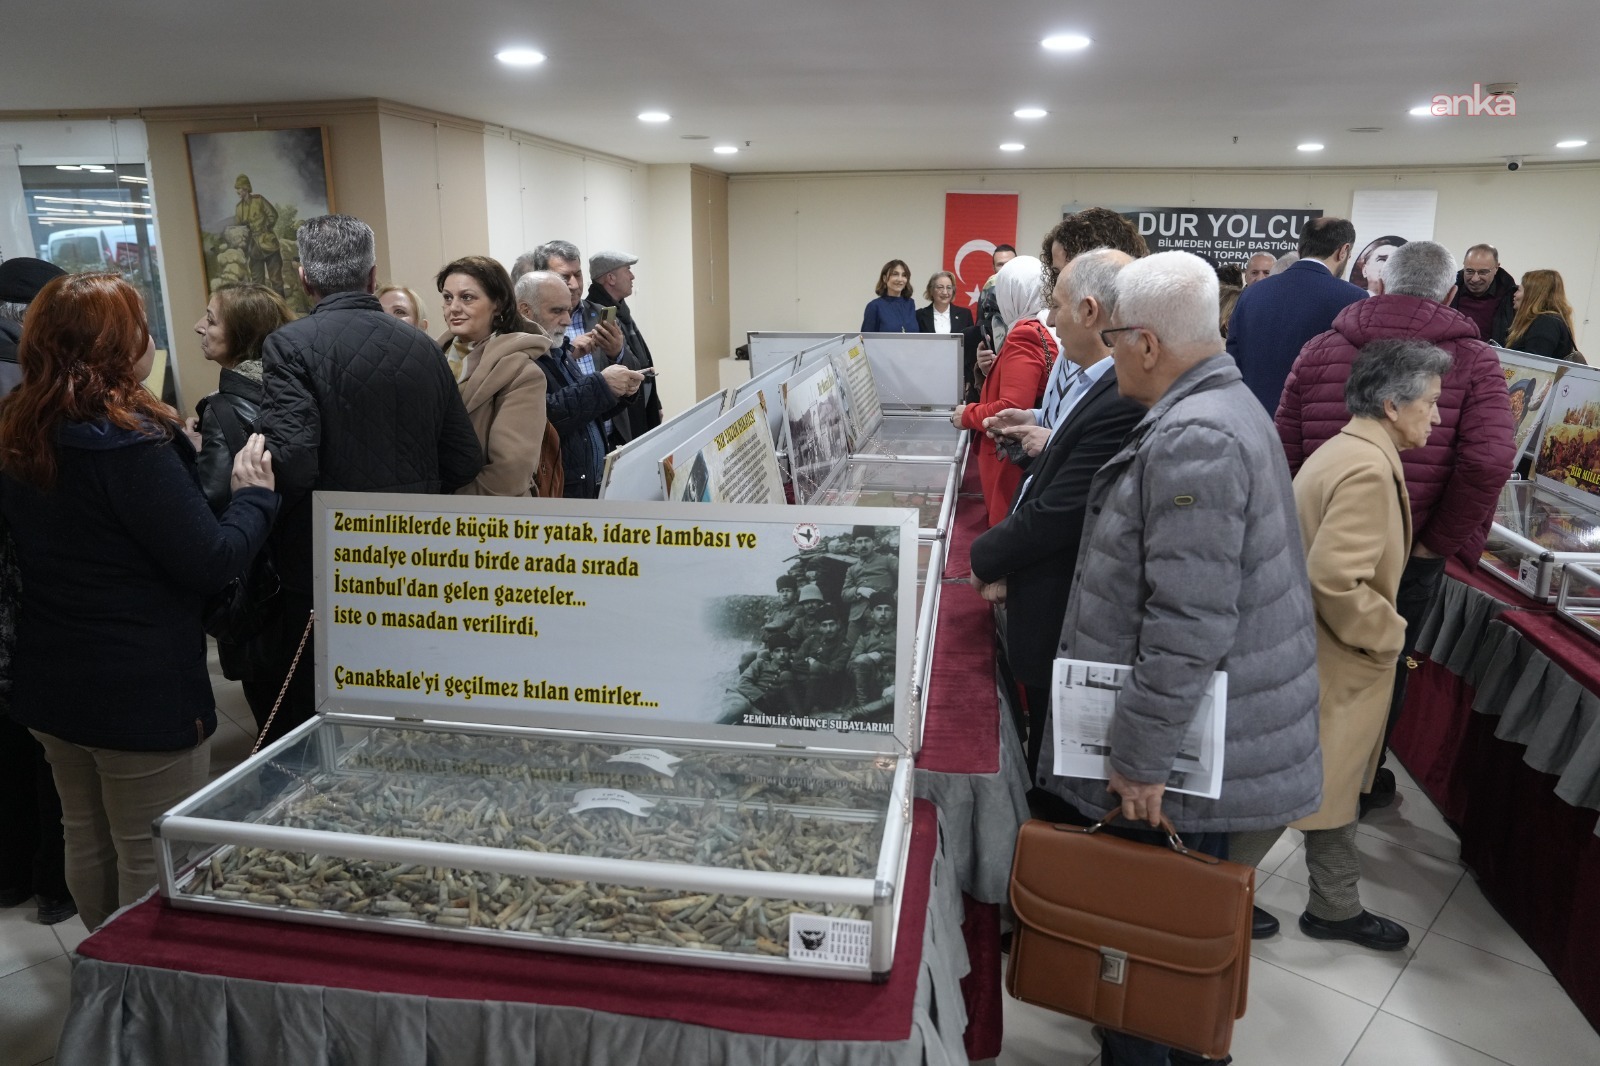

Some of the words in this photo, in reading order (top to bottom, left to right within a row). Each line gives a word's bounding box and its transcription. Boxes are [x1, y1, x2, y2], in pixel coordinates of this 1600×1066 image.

[1138, 213, 1199, 237] DUR
[1207, 214, 1310, 239] YOLCU
[1158, 237, 1212, 249] BİLMEDEN
[1214, 239, 1246, 250] GELİP
[1248, 240, 1299, 251] BASTIĞIN
[334, 511, 452, 536] Zeminliklerde
[455, 516, 509, 543] küçük
[513, 520, 540, 540] bir
[543, 522, 598, 545] yatak,
[602, 523, 651, 545] idare
[655, 524, 731, 549] lambası
[735, 532, 757, 549] ve
[334, 544, 407, 569] sandalye
[411, 547, 470, 569] olurdu
[474, 549, 520, 571] birde
[524, 553, 577, 574] arada
[581, 556, 639, 577] sırada
[334, 568, 439, 599] İstanbul'dan
[443, 580, 490, 604] gelen
[494, 584, 586, 607] gazeteler...
[334, 605, 362, 625] iste
[366, 610, 377, 626] o
[381, 610, 458, 631] masadan
[462, 614, 539, 638] verilirdi,
[334, 665, 440, 695] Çanakkale'yi
[444, 675, 519, 700] geçilmez
[523, 679, 570, 701] kılan
[574, 684, 660, 708] emirler....
[743, 712, 788, 727] ZEMİNLİK
[789, 714, 828, 729] ÖNÜNCE
